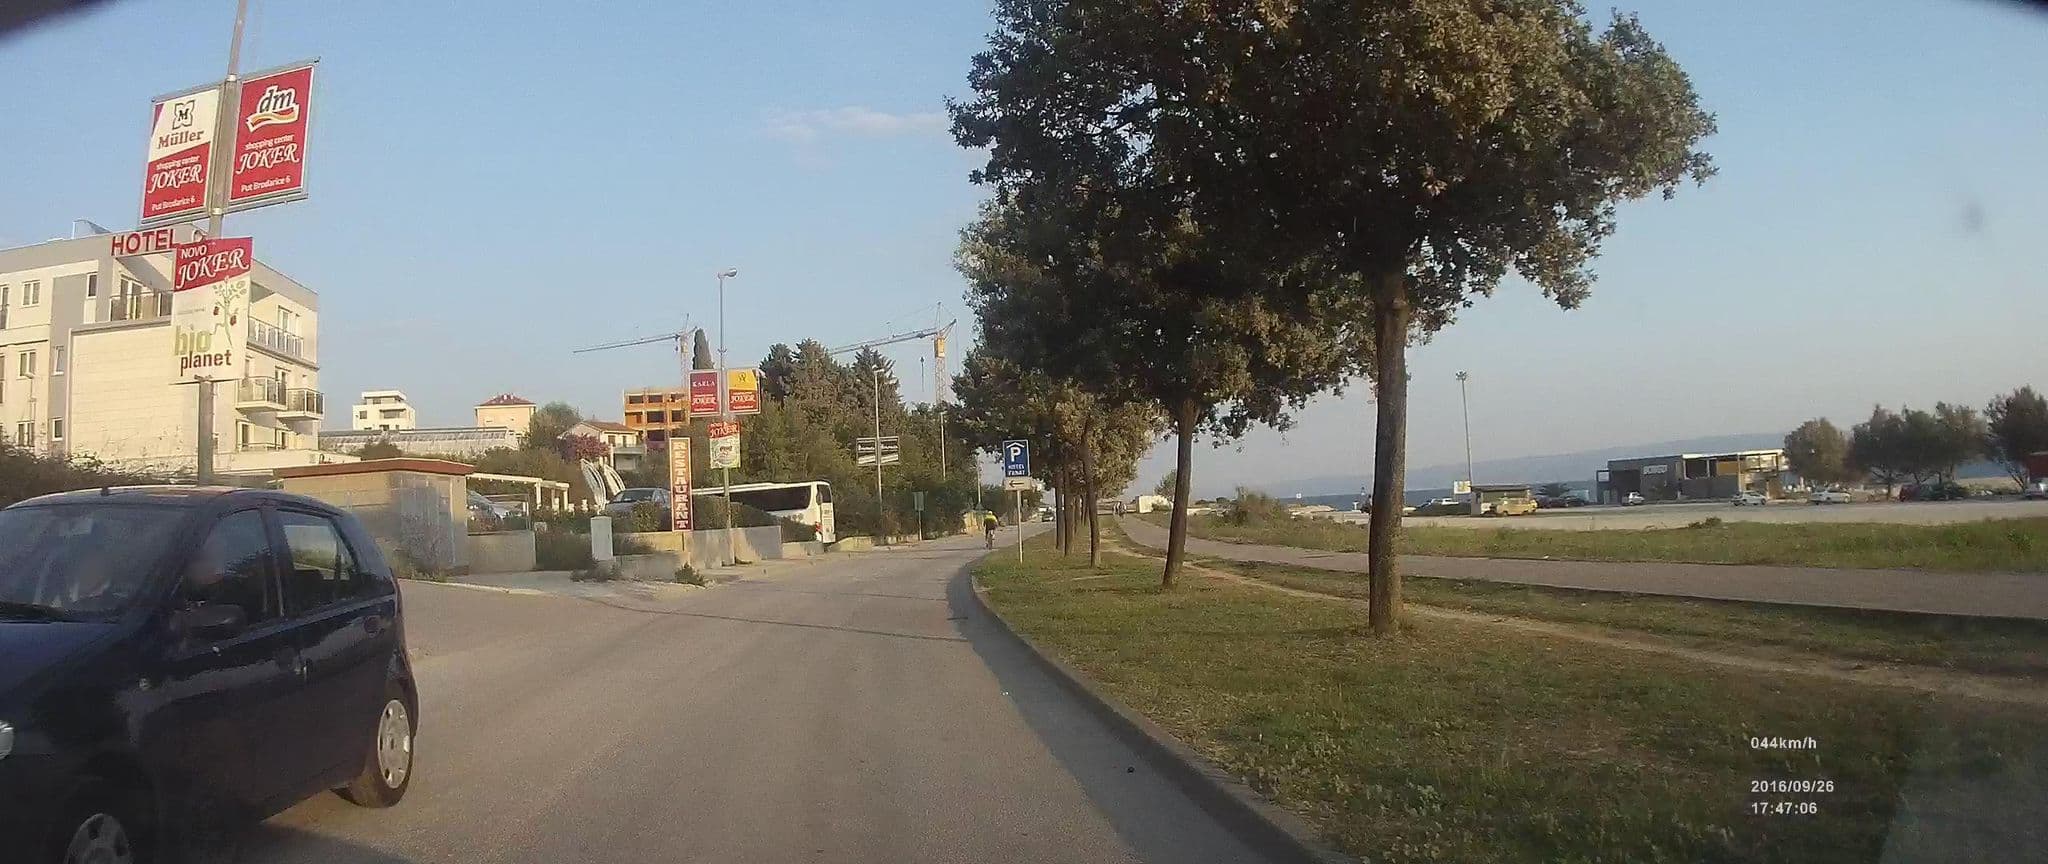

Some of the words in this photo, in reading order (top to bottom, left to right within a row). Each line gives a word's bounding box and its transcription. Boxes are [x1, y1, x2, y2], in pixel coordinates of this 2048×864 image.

[259, 88, 294, 114] dm
[158, 130, 204, 149] Müller
[245, 138, 273, 151] shopping
[273, 134, 294, 144] center
[156, 160, 181, 171] shopping
[235, 143, 300, 175] JOKER
[147, 164, 204, 194] JOKER
[240, 183, 253, 193] Put
[253, 177, 285, 190] Brodarice
[285, 174, 291, 184] 6
[151, 203, 163, 212] Put
[111, 228, 181, 256] HOTEL
[181, 244, 207, 259] NOVO
[175, 247, 250, 289] JOKER
[174, 323, 212, 356] bio
[179, 349, 232, 377] planet
[1010, 446, 1022, 463] P
[673, 441, 689, 529] RESTAURANT
